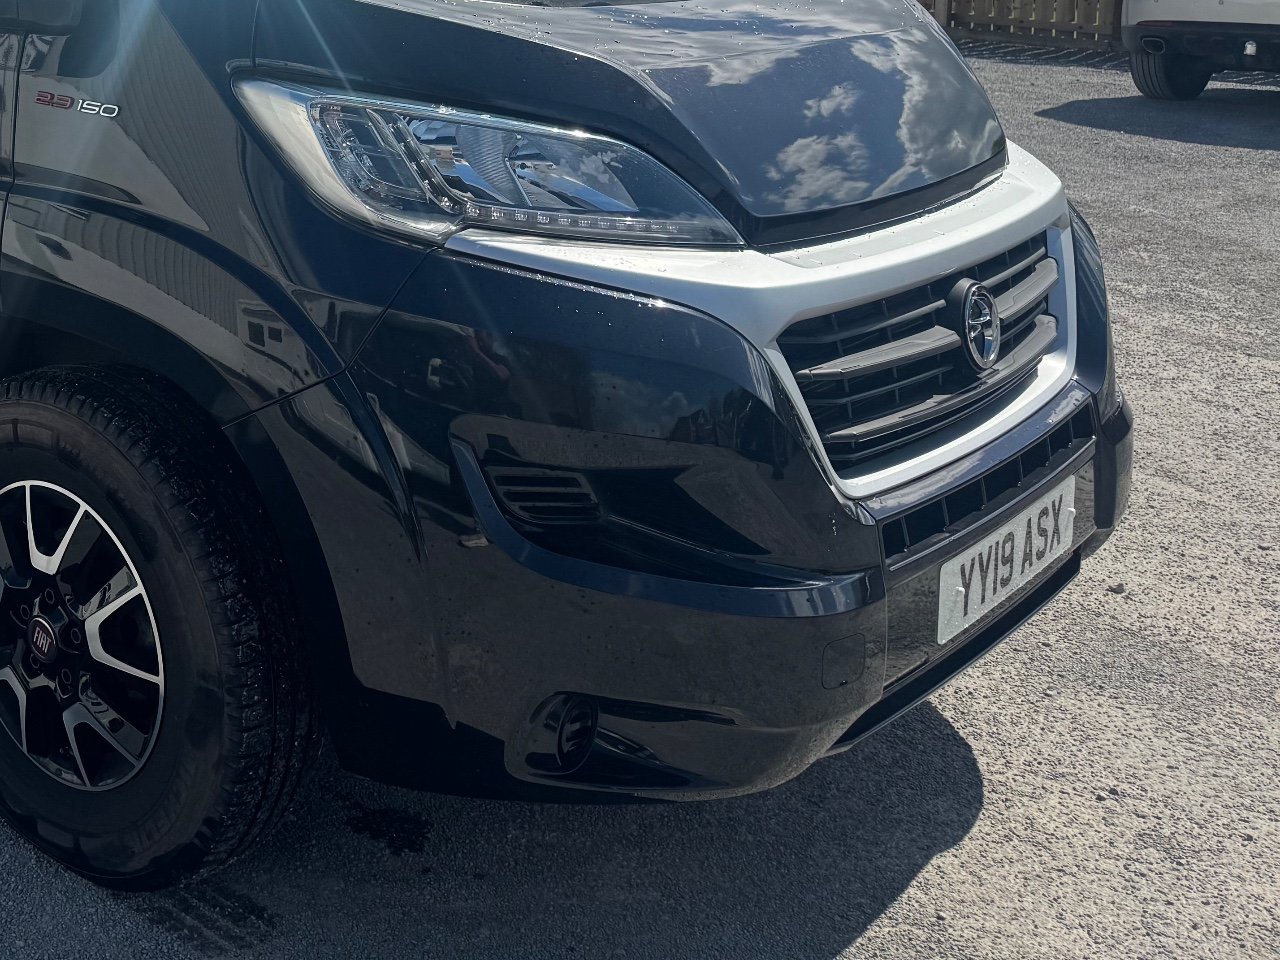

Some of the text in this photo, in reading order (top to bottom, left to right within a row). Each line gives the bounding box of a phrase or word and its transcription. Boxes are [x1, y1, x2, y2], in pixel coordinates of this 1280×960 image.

[77, 99, 119, 117] 150
[960, 493, 1063, 618] YY19 ASX
[33, 626, 51, 653] FIAT
